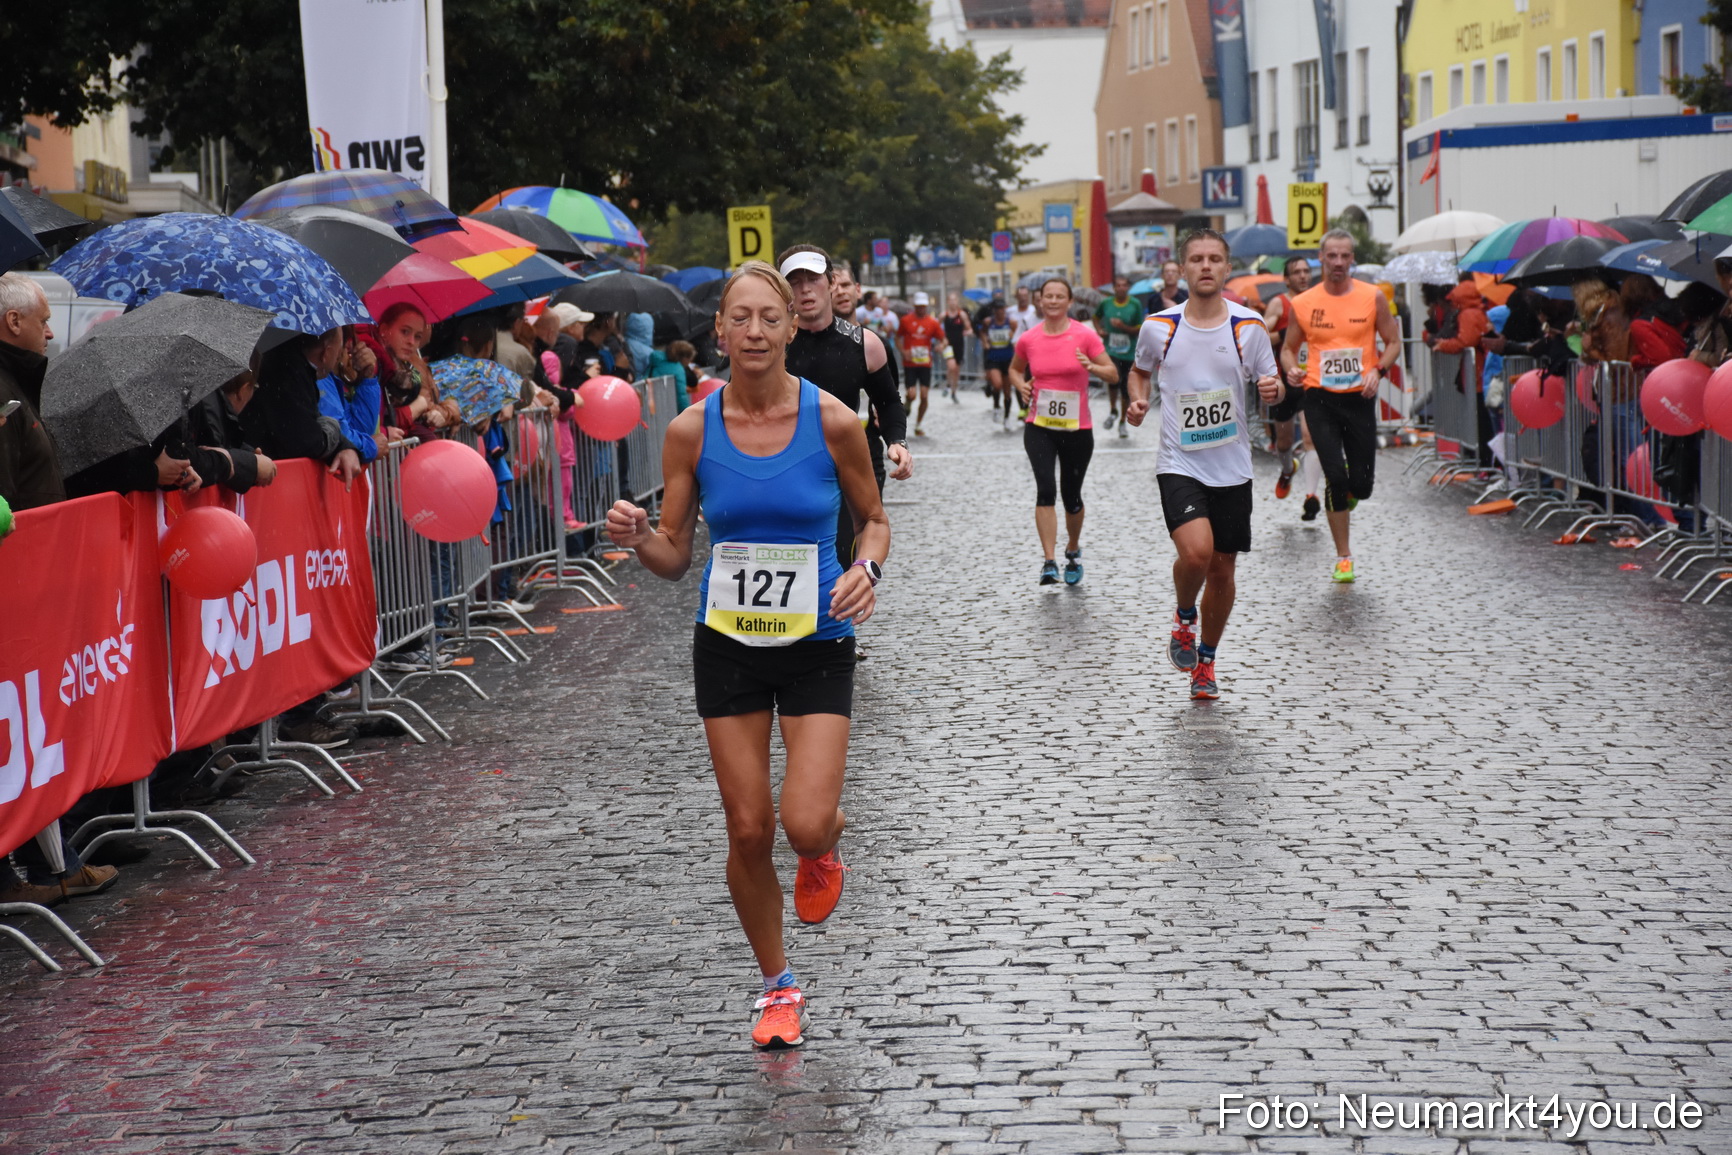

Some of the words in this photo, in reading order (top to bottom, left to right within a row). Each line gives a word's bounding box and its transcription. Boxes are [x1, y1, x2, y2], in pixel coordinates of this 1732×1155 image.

[1456, 22, 1484, 53] HOTEL
[1293, 185, 1324, 197] Block
[733, 209, 765, 222] Block
[1298, 203, 1317, 234] D
[740, 226, 761, 257] D
[1324, 357, 1360, 375] 2500
[1048, 400, 1067, 416] 86
[1183, 400, 1232, 429] 2862
[1190, 428, 1228, 443] Christoph
[720, 554, 750, 562] NeuerMarkt
[755, 547, 809, 561] BOCK
[732, 569, 797, 608] 127
[736, 616, 787, 633] Kathrin
